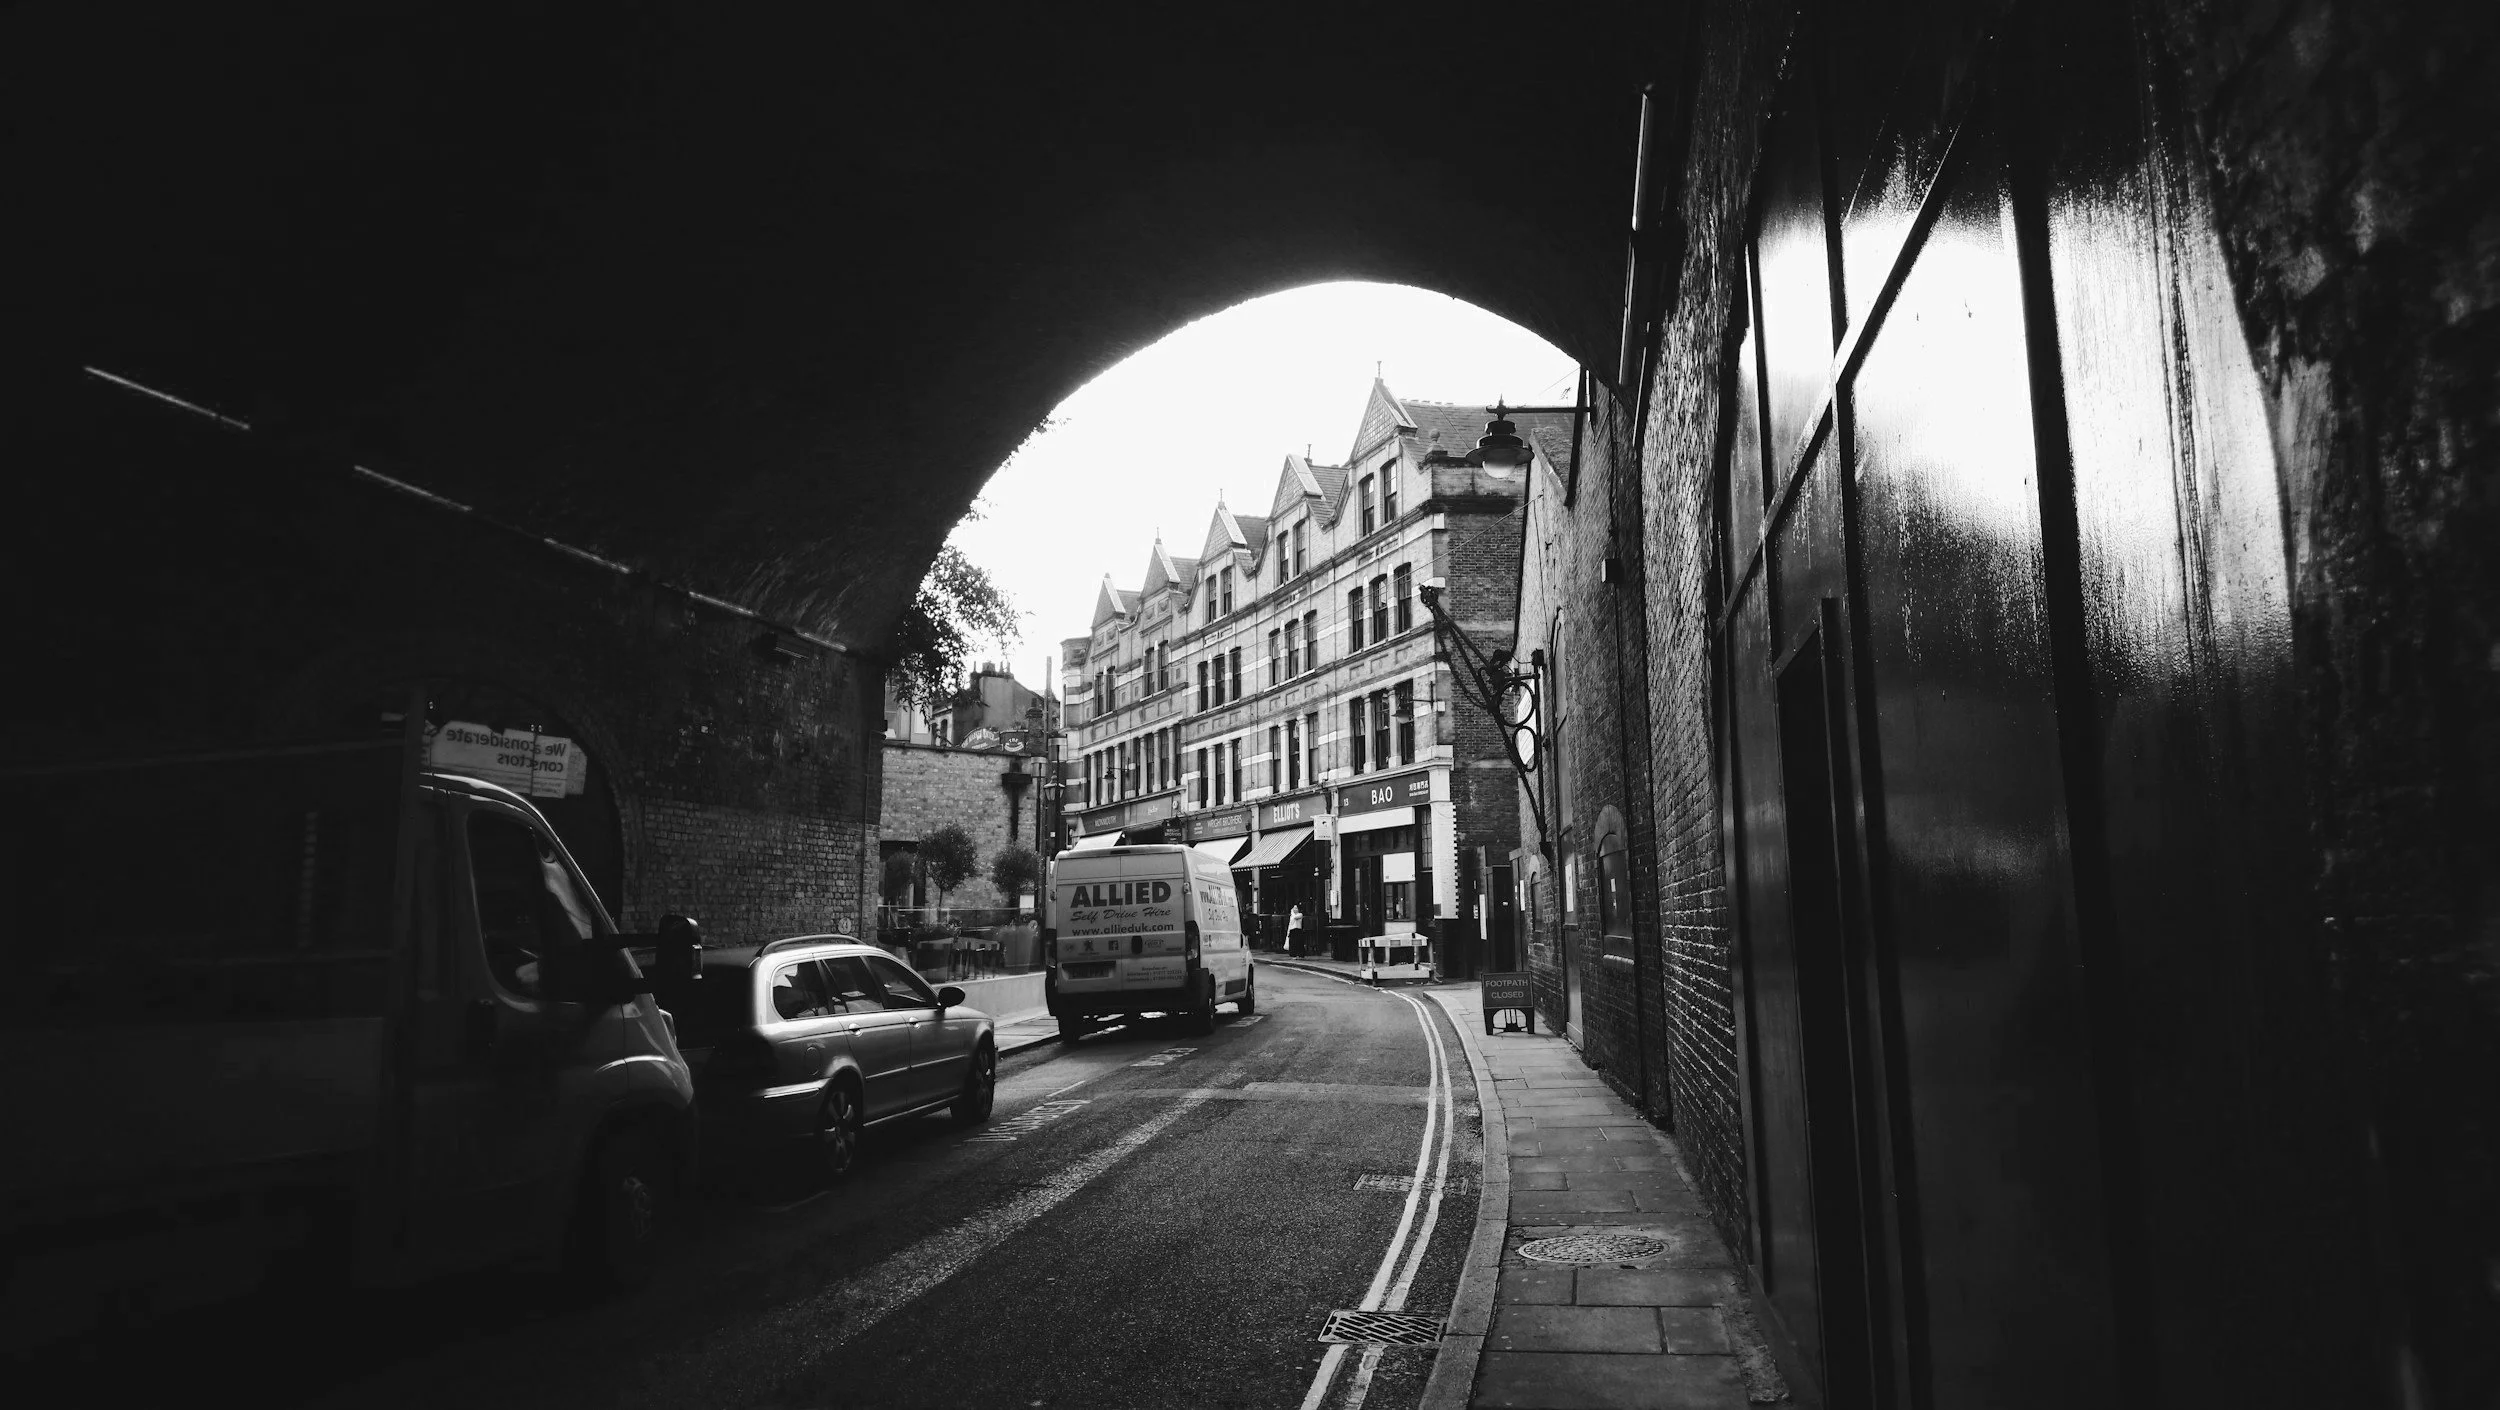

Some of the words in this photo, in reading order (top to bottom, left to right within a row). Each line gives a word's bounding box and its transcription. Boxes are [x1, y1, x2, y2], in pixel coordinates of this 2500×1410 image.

[1371, 786, 1393, 805] BAO
[1273, 802, 1300, 823] ELLIOT'S
[1070, 881, 1172, 909] ALLIED
[1070, 910, 1099, 924] Self
[1103, 909, 1139, 920] Drive
[1142, 907, 1172, 918] Hire
[1072, 922, 1174, 936] www.allieduk.com
[1485, 979, 1529, 988] FOOTPATH
[1491, 991, 1524, 999] CLOSED
